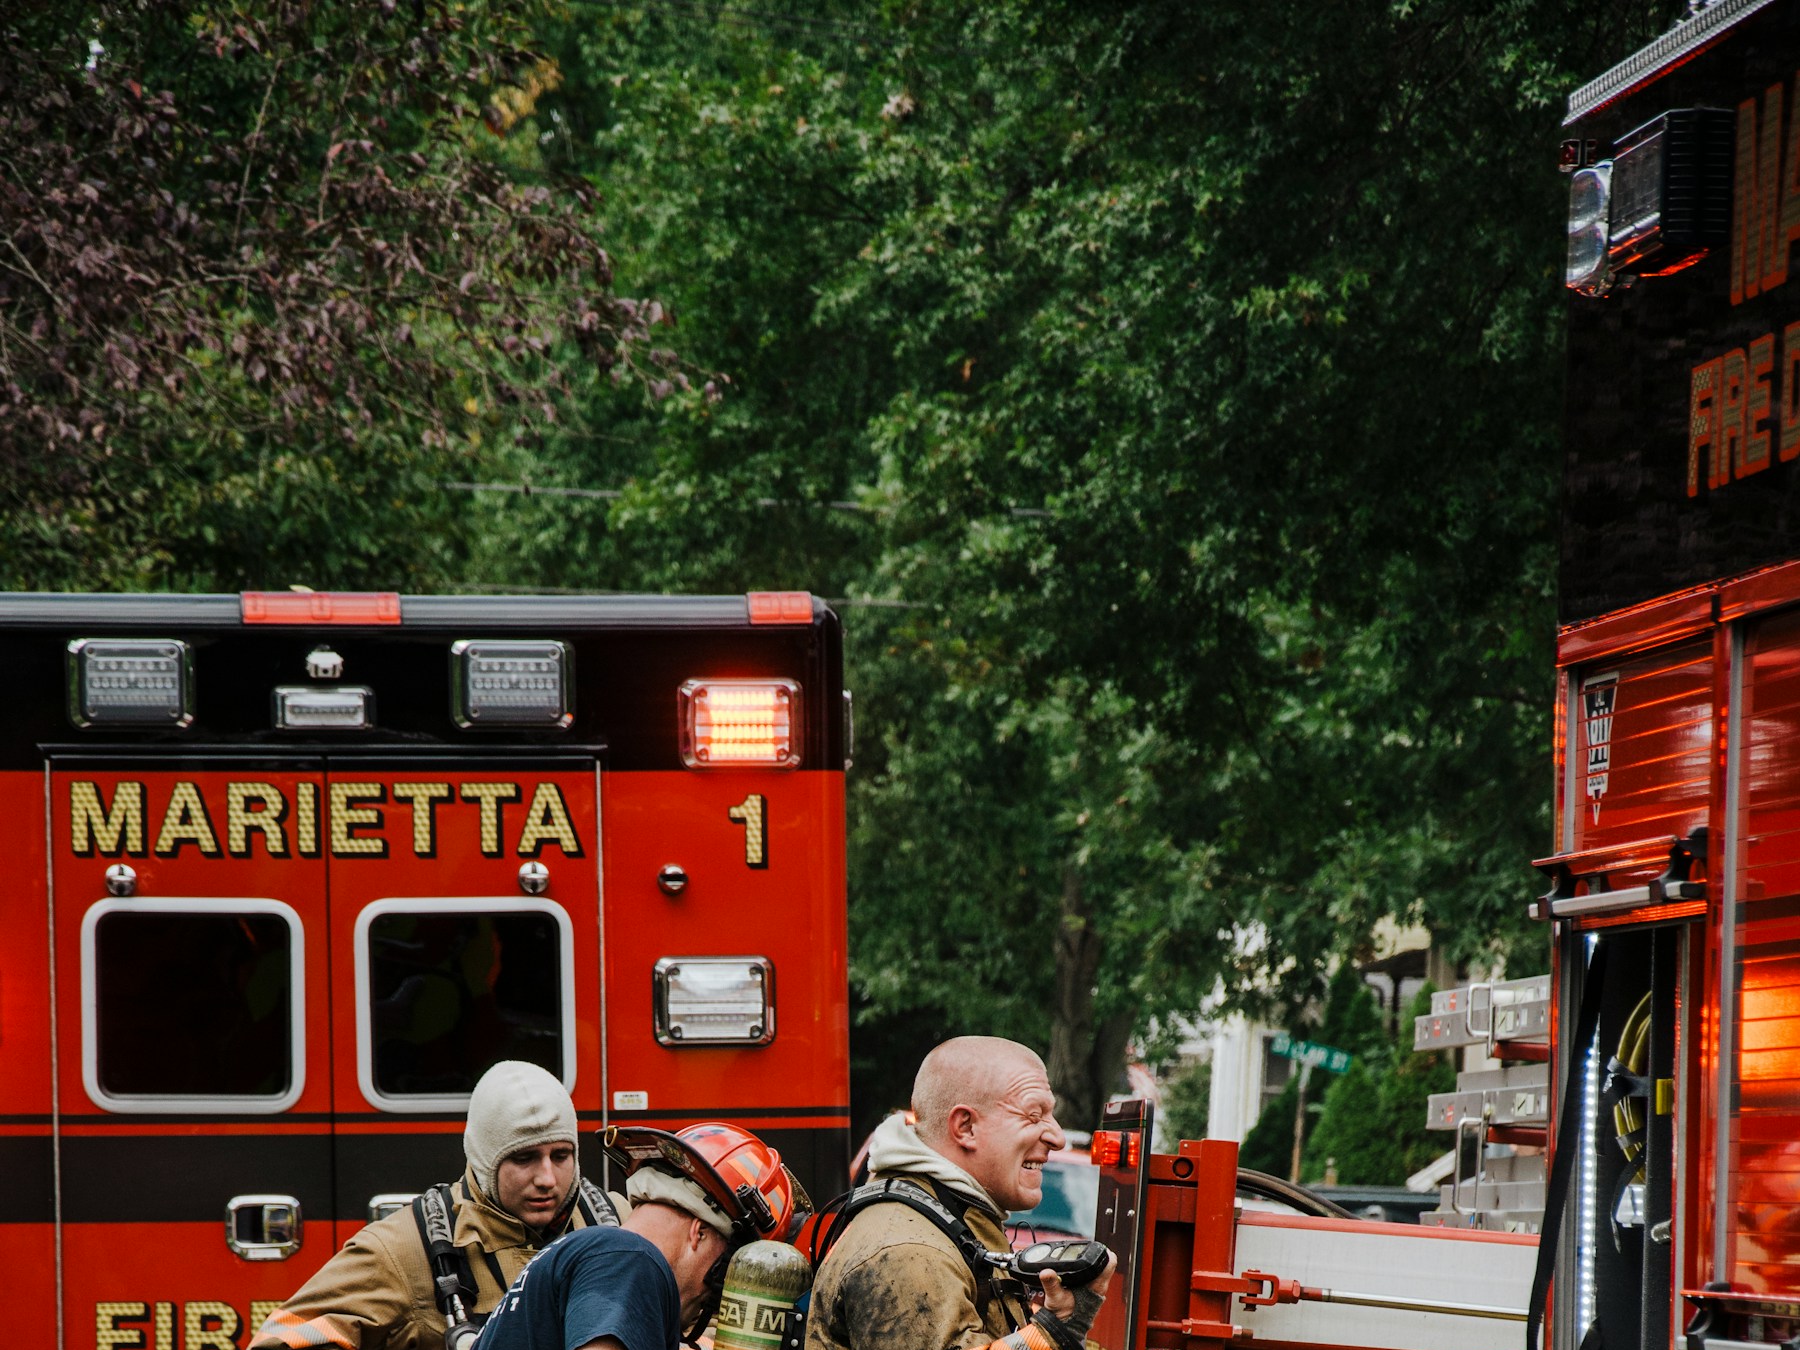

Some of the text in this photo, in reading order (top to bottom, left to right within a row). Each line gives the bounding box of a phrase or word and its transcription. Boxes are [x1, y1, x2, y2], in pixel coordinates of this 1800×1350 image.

[1687, 333, 1774, 497] FIRE
[70, 781, 584, 858] MARIETTA
[729, 794, 768, 869] 1
[1331, 1051, 1348, 1070] ST
